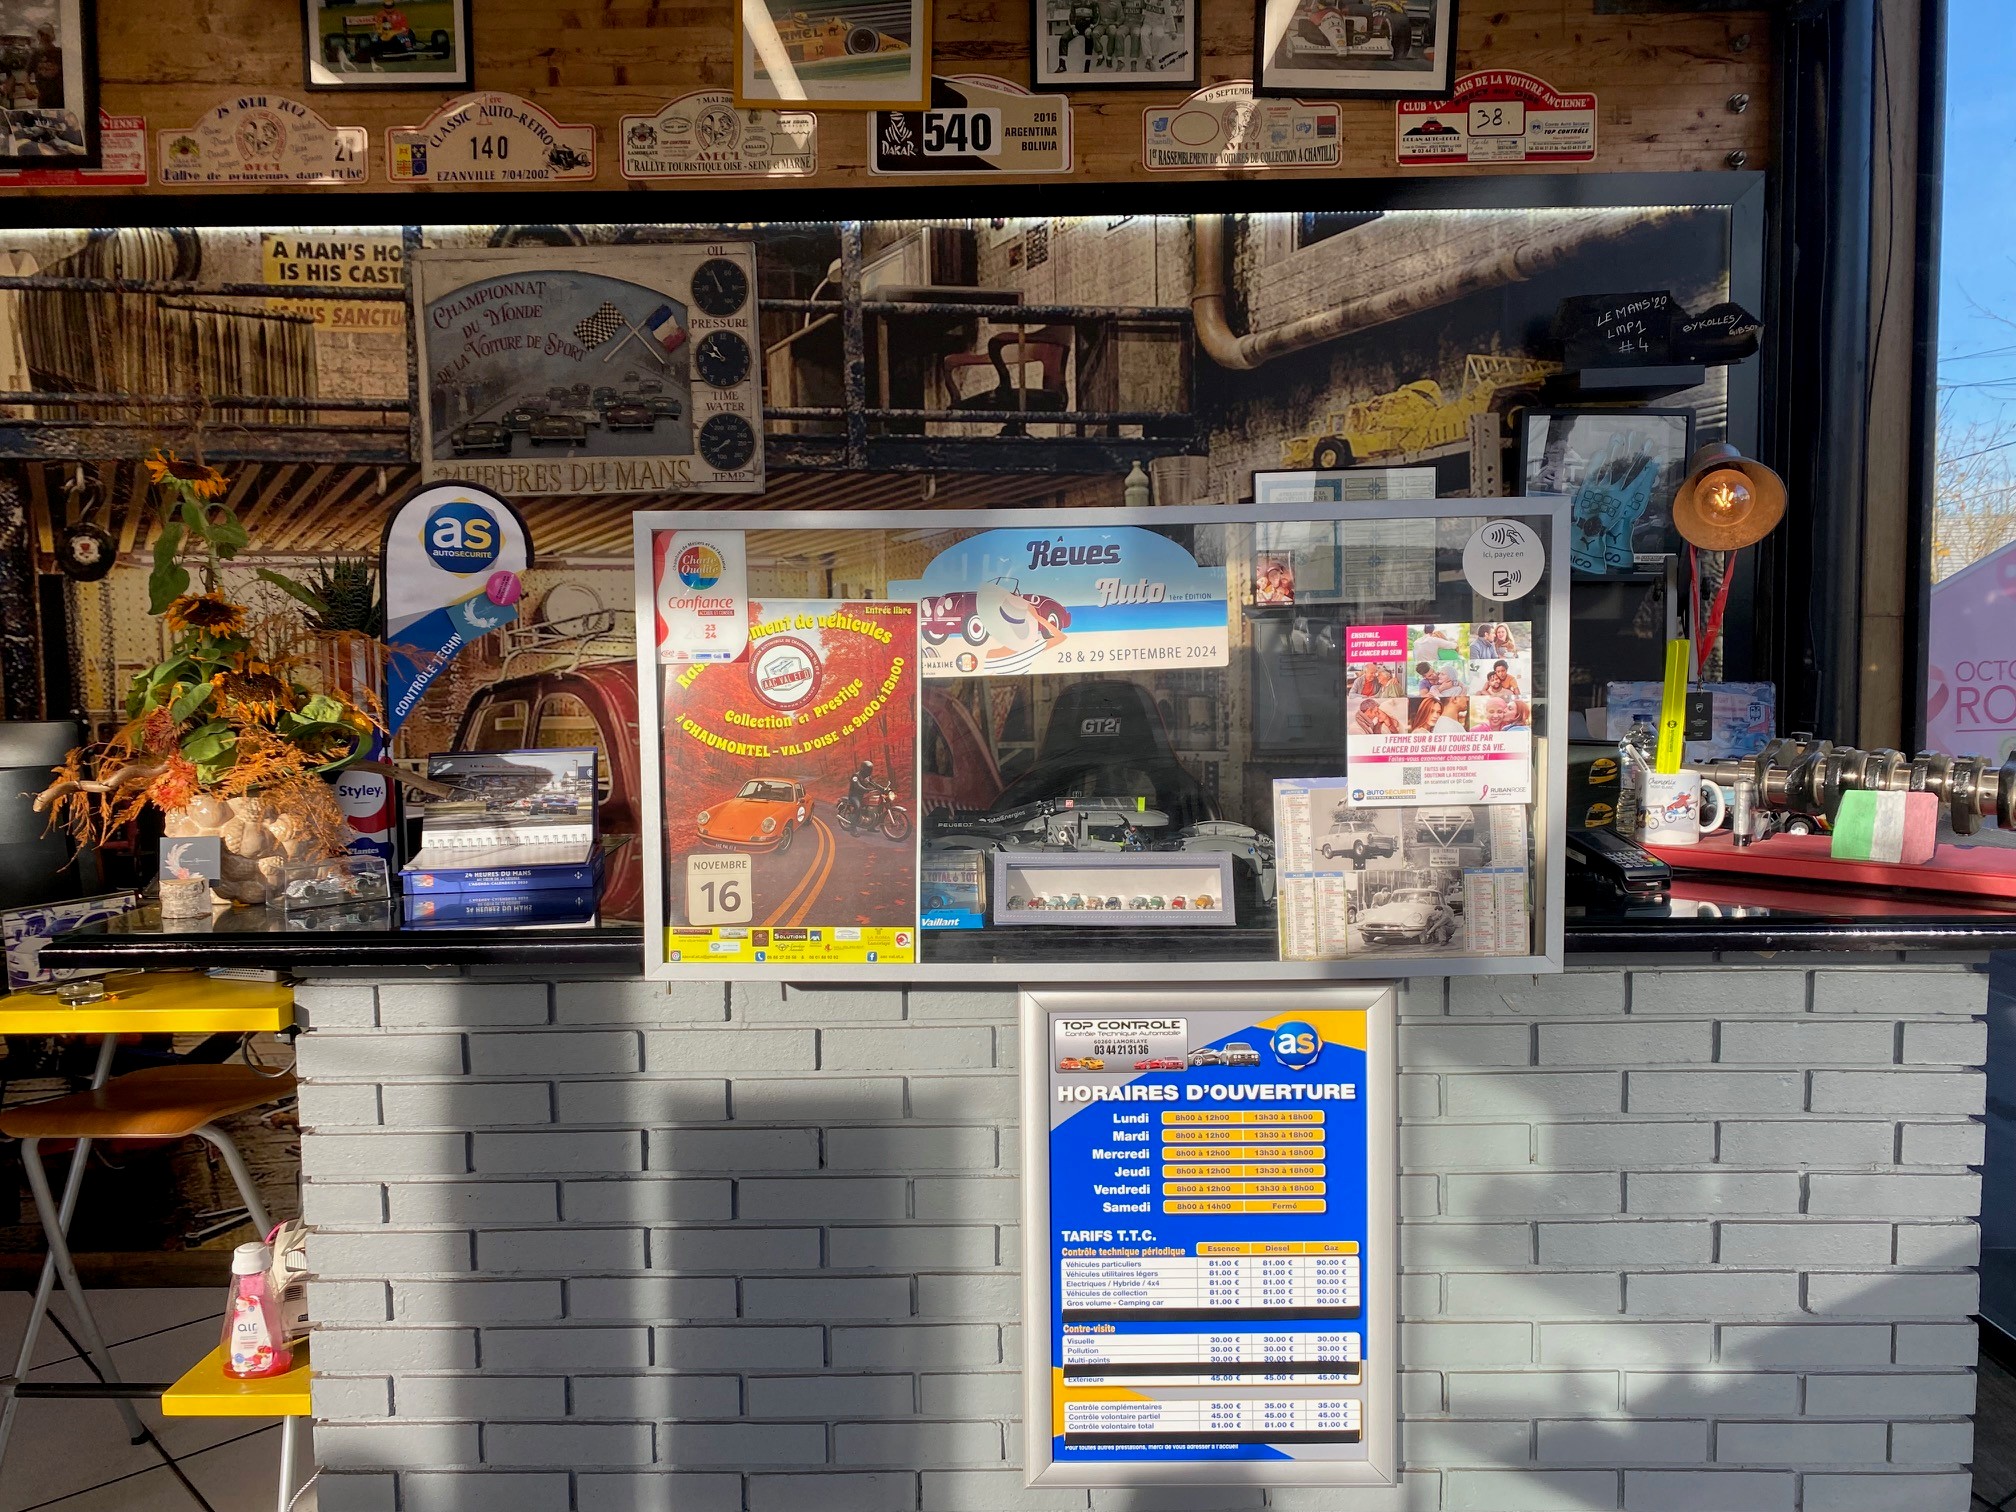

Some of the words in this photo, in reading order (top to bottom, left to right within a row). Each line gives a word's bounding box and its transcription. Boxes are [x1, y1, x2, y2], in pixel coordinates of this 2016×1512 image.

[1403, 102, 1427, 111] CLUB
[1475, 75, 1488, 86] DE
[1489, 74, 1503, 84] LA
[1505, 75, 1544, 96] VOITURE
[1034, 112, 1057, 122] 2016
[430, 109, 472, 148] CLASSIC
[479, 105, 554, 146] AUTO-RETRO
[924, 113, 992, 152] 540
[1004, 126, 1057, 137] ARGENTINA
[470, 135, 508, 160] 140
[881, 140, 916, 156] DAKAR
[1021, 141, 1057, 151] BOLIVIA
[1158, 149, 1208, 165] RASSEMBLEMENT
[1260, 149, 1298, 163] COLLECTION
[1304, 143, 1337, 162] CHANTILLY
[634, 160, 665, 172] RALLYE
[667, 161, 722, 173] TOURISTIQUE
[724, 161, 743, 170] OISE
[748, 160, 772, 170] SEINE
[781, 157, 811, 169] MARNE
[437, 170, 495, 181] EZANVILLE
[501, 169, 550, 180] 7/04/2002
[273, 241, 289, 258] A
[296, 242, 366, 261] MAN'S
[707, 245, 728, 256] OIL
[279, 263, 299, 280] IS
[307, 263, 342, 281] HIS
[433, 281, 547, 329] CHAMPIONNAT
[461, 320, 480, 339] DU
[483, 303, 543, 327] MONDE
[690, 319, 748, 330] PRESSURE
[1597, 310, 1613, 327] LE
[1607, 320, 1647, 339] LMP1
[1618, 340, 1635, 353] #
[1639, 337, 1650, 352] 4
[437, 365, 454, 383] DE
[453, 353, 470, 371] LA
[464, 333, 528, 361] VOITURE
[526, 335, 542, 349] DE
[544, 332, 587, 363] SPORT
[712, 391, 739, 401] TIME
[706, 402, 746, 412] WATER
[568, 462, 608, 492] DU
[613, 459, 692, 491] MANS
[712, 472, 746, 482] TEMP
[432, 516, 493, 550] as
[1026, 535, 1123, 571] Rêves
[1494, 551, 1515, 560] payez
[682, 555, 716, 565] Charte
[681, 564, 719, 577] Qualité
[1094, 577, 1167, 609] Auto
[1184, 592, 1213, 601] ÉDITION
[668, 594, 734, 612] Confiance
[865, 606, 891, 616] Entrée
[893, 605, 912, 615] libre
[749, 615, 792, 642] ment
[794, 613, 814, 630] de
[816, 611, 894, 646] véhicules
[1057, 650, 1073, 664] 28
[1076, 650, 1087, 662] &
[1089, 649, 1105, 663] 29
[1108, 646, 1183, 661] SEPTEMBRE
[1186, 644, 1218, 659] 2024
[394, 662, 438, 718] CONTRÔLE
[436, 633, 463, 666] TECHN
[681, 720, 772, 758] CHAUMONTEL
[780, 743, 804, 757] VAL
[804, 731, 841, 753] D'OISE
[842, 724, 856, 736] de
[852, 700, 882, 729] 9H00
[880, 656, 906, 698] 13H00
[723, 708, 793, 729] Collection
[798, 713, 810, 725] et
[813, 676, 864, 718] Prestige
[1388, 735, 1412, 744] FEMME
[1413, 735, 1427, 743] SUR
[1434, 734, 1448, 743] EST
[1448, 733, 1480, 743] TOUCHÉE
[1480, 733, 1495, 742] PAR
[986, 809, 1027, 824] TotalEnergies
[938, 821, 974, 829] PEUGEOT
[693, 859, 748, 870] NOVEMBRE
[512, 869, 532, 877] MANS
[926, 871, 952, 883] TOTAL
[700, 879, 742, 914] 16
[920, 916, 961, 927] Vaillant
[774, 931, 808, 940] SOLUTIONS
[1062, 1021, 1094, 1030] TOP
[1101, 1020, 1181, 1030] CONTROLE
[1064, 1030, 1098, 1038] Contrôle
[1098, 1030, 1139, 1038] Technique
[1139, 1029, 1181, 1037] Automobile
[1277, 1032, 1317, 1055] as
[1057, 1084, 1180, 1102] HORAIRES
[1186, 1082, 1357, 1101] D'OUVERTURE
[1113, 1113, 1149, 1124] Lundi
[1113, 1130, 1150, 1142] Mardi
[1091, 1148, 1150, 1160] Mercredi
[1114, 1166, 1150, 1178] Jeudi
[1093, 1184, 1151, 1196] Vendredi
[1101, 1202, 1151, 1213] Samedi
[1271, 1202, 1298, 1210] Fermé
[1061, 1230, 1114, 1243] TARIFS
[1117, 1229, 1157, 1242] T.T.C.
[1061, 1246, 1097, 1257] Contrôle
[1098, 1246, 1139, 1257] technique
[1140, 1246, 1186, 1257] périodique
[1264, 1244, 1290, 1252] Diesel
[1323, 1243, 1339, 1251] Gaz
[1066, 1260, 1101, 1268] Véhicules
[1101, 1260, 1142, 1269] particuliers
[1208, 1259, 1232, 1267] 81.00
[1062, 1324, 1116, 1334] Contre-visite
[1067, 1403, 1100, 1411] Contrôle
[1100, 1403, 1163, 1412] complémentaires
